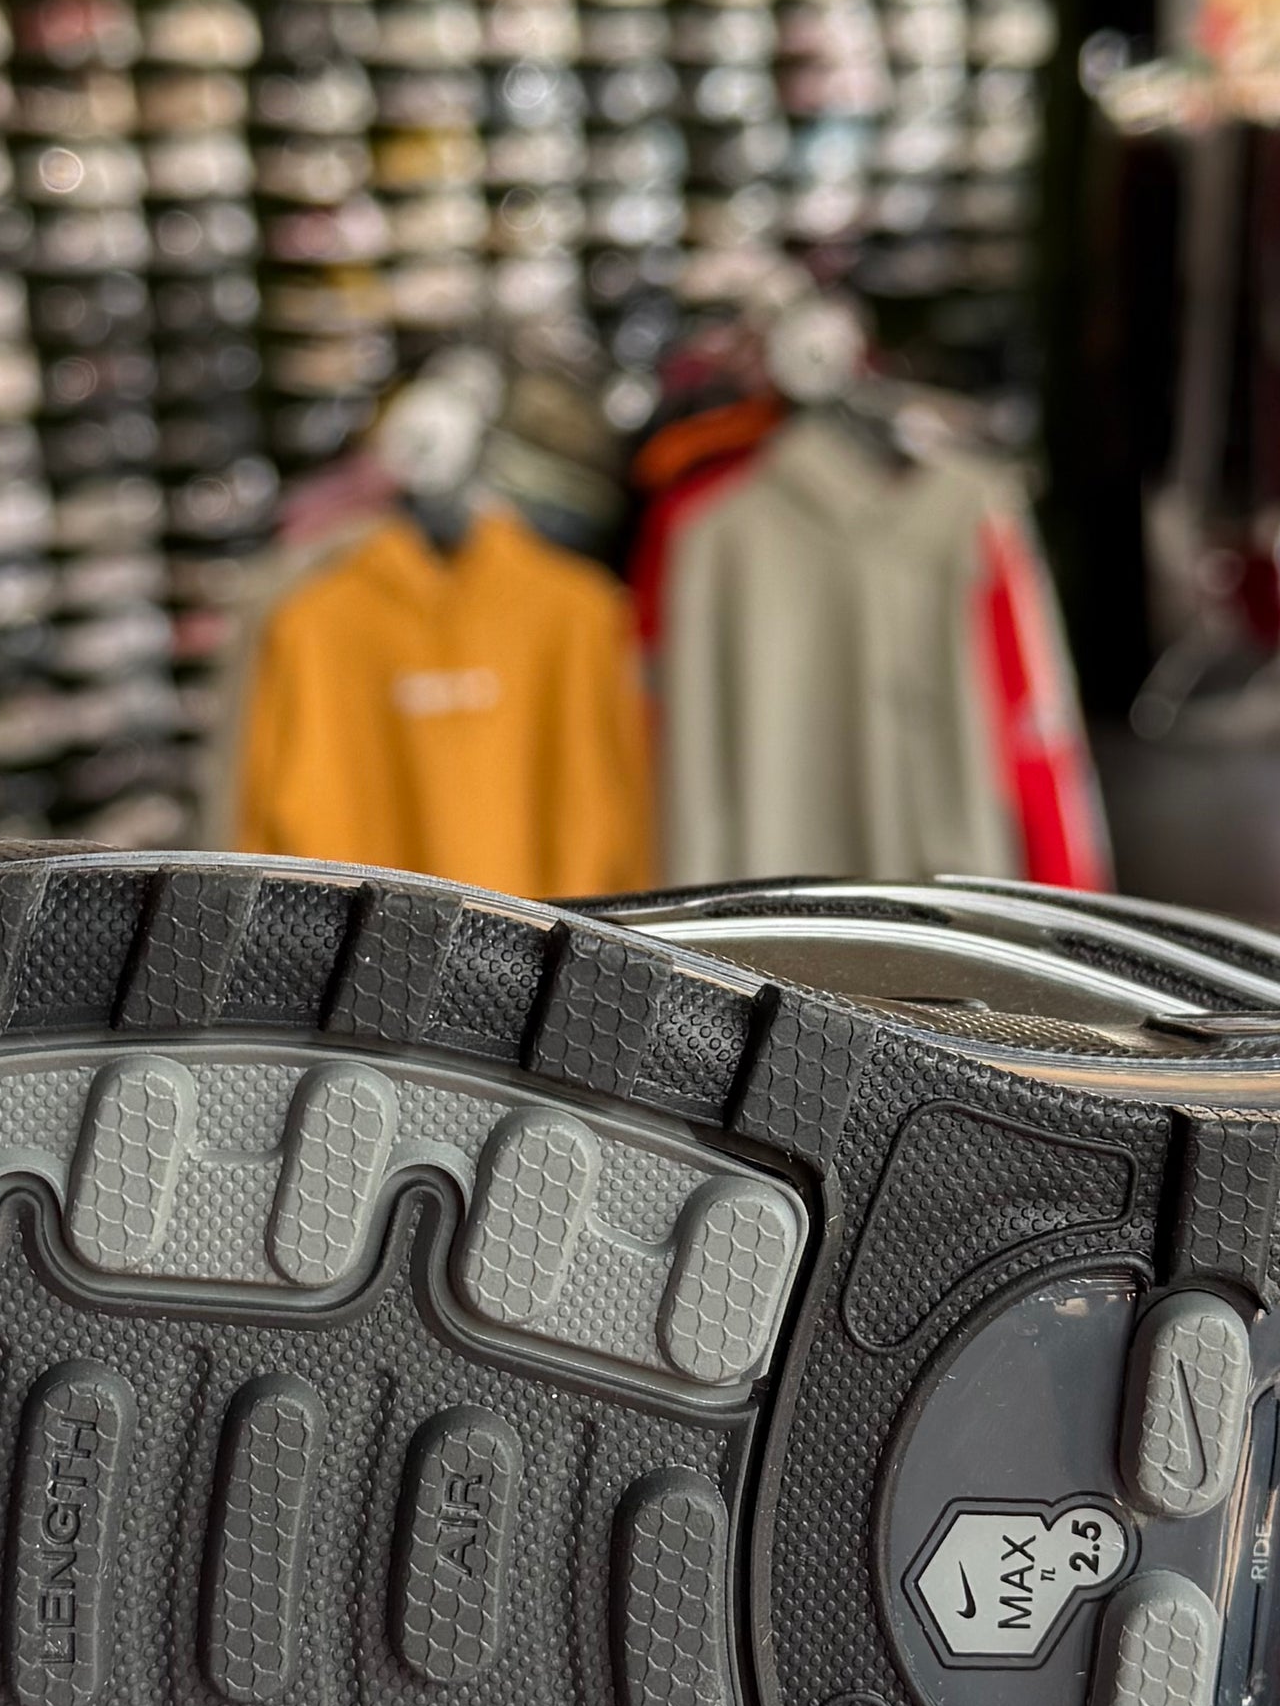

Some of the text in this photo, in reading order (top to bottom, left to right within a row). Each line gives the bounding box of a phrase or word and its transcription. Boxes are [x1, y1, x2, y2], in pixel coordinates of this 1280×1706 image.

[37, 1416, 97, 1664] LENGTH
[436, 1471, 483, 1579] AIR
[1069, 1519, 1102, 1575] 2.5
[1250, 1523, 1272, 1581] RIDE
[998, 1534, 1036, 1629] MAX
